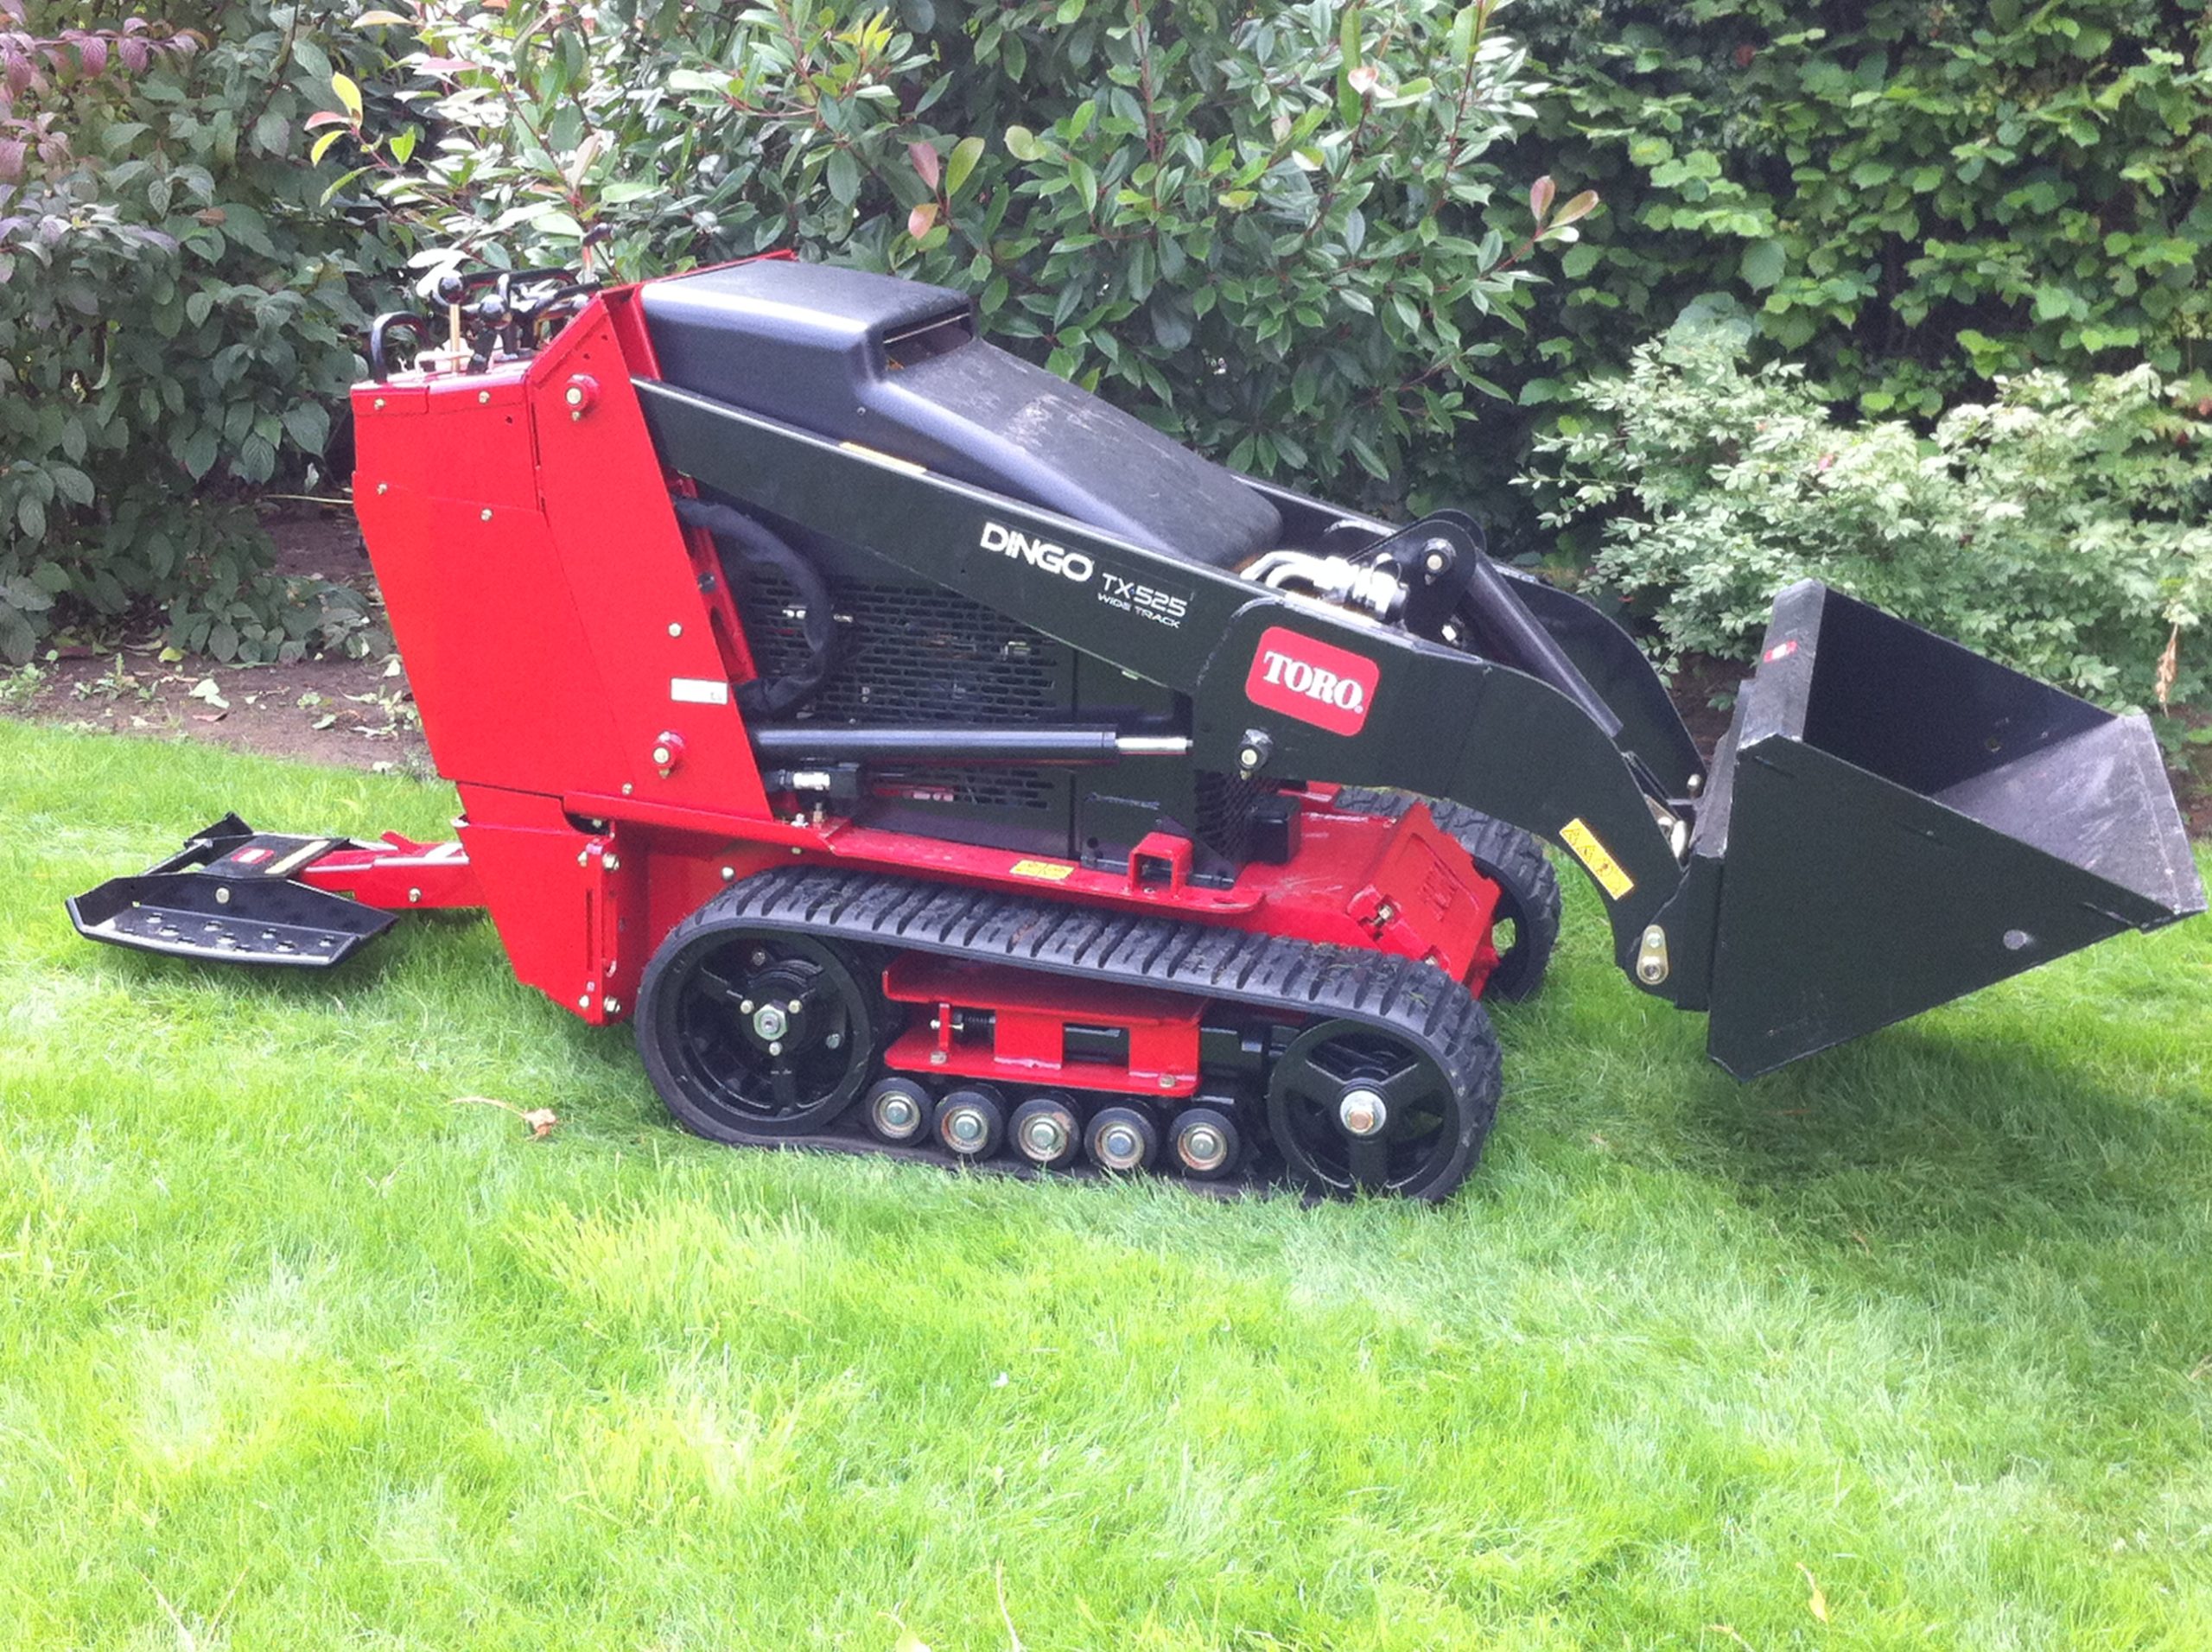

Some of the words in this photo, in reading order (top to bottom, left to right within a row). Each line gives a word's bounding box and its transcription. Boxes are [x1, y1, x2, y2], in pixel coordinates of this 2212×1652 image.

[980, 521, 1095, 582] DINGO
[1097, 592, 1132, 612] WIDE
[1135, 605, 1180, 629] TRACK
[1262, 650, 1363, 711] TORO
